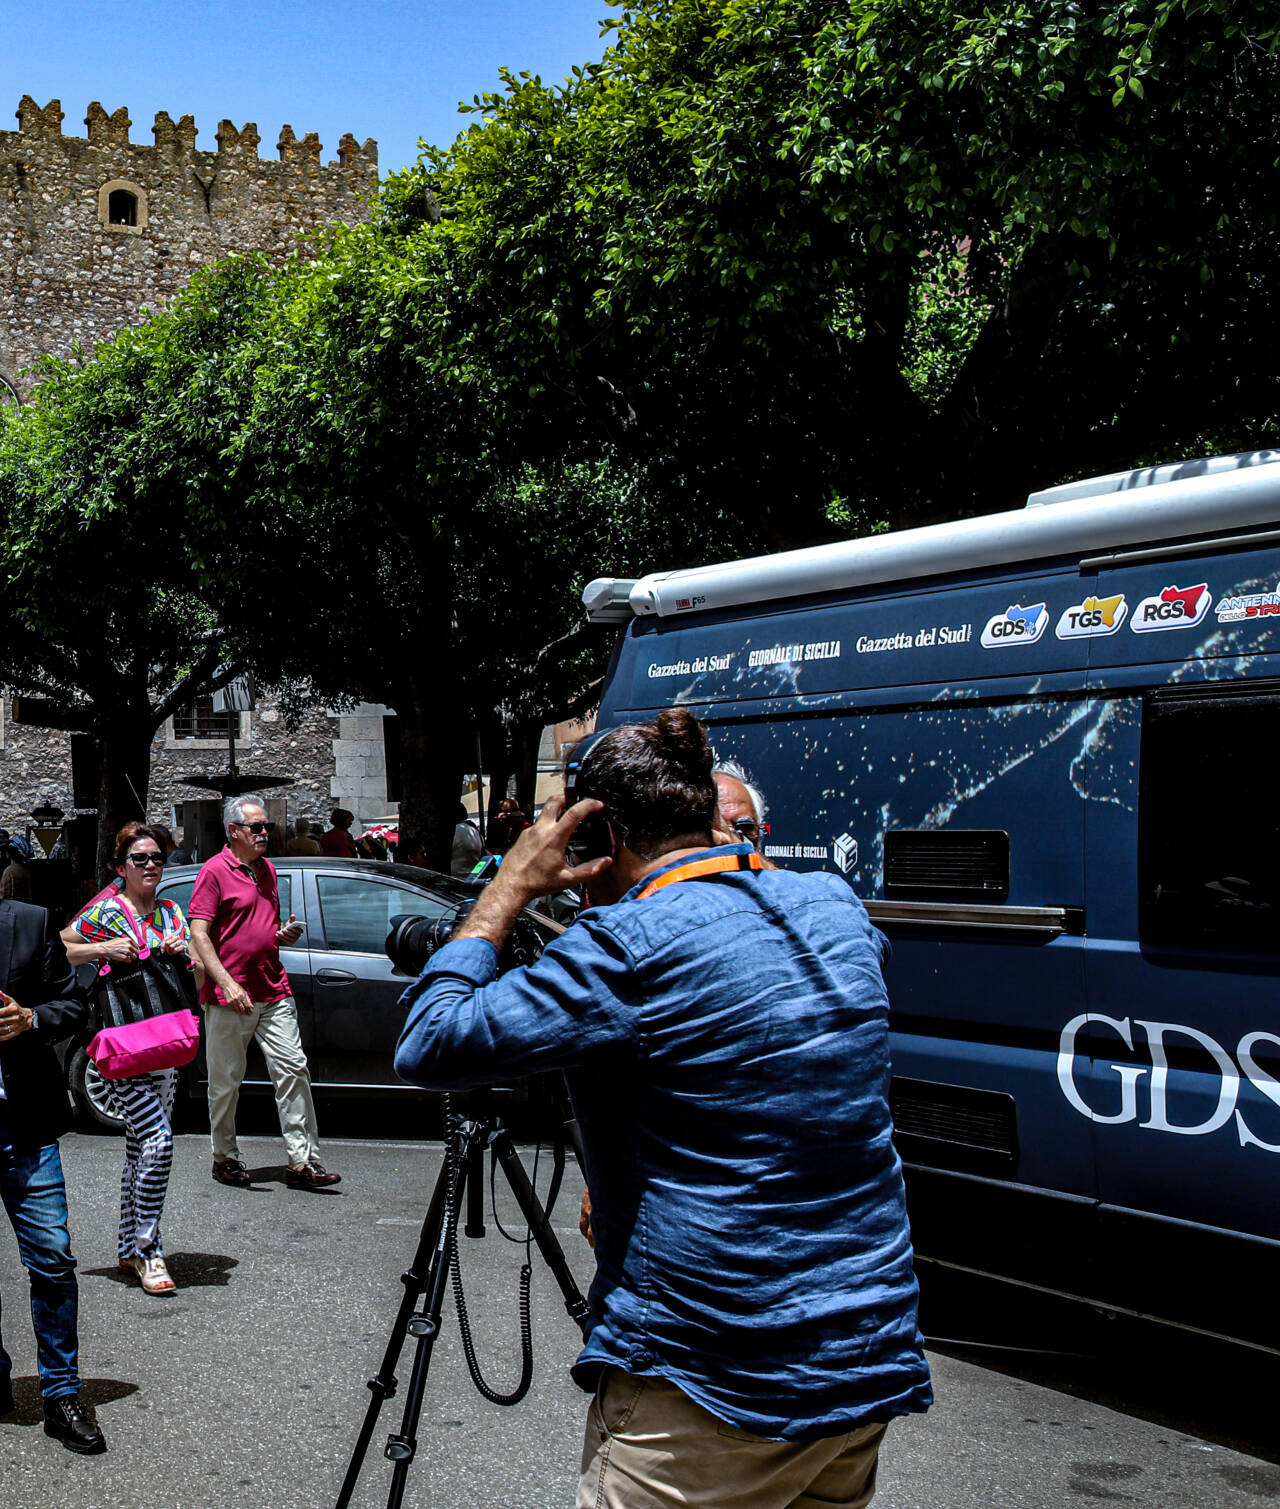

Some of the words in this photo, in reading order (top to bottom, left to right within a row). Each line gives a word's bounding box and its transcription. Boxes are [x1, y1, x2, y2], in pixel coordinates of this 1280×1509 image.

[1069, 610, 1102, 629] TGS
[1143, 601, 1185, 622] RGS
[856, 634, 913, 653] Gazzetta
[915, 629, 936, 647] del
[937, 624, 967, 645] Sud
[991, 619, 1026, 638] GDS
[748, 646, 792, 667] GIORNALE
[792, 645, 803, 662] DI
[804, 641, 841, 659] SICILIA
[648, 661, 690, 678] Gazzetta
[691, 658, 708, 673] del
[708, 654, 730, 671] Sud
[764, 845, 794, 858] GIORNALE
[795, 845, 802, 858] DI
[803, 846, 828, 858] SICILIA
[1057, 1012, 1280, 1153] GDS
